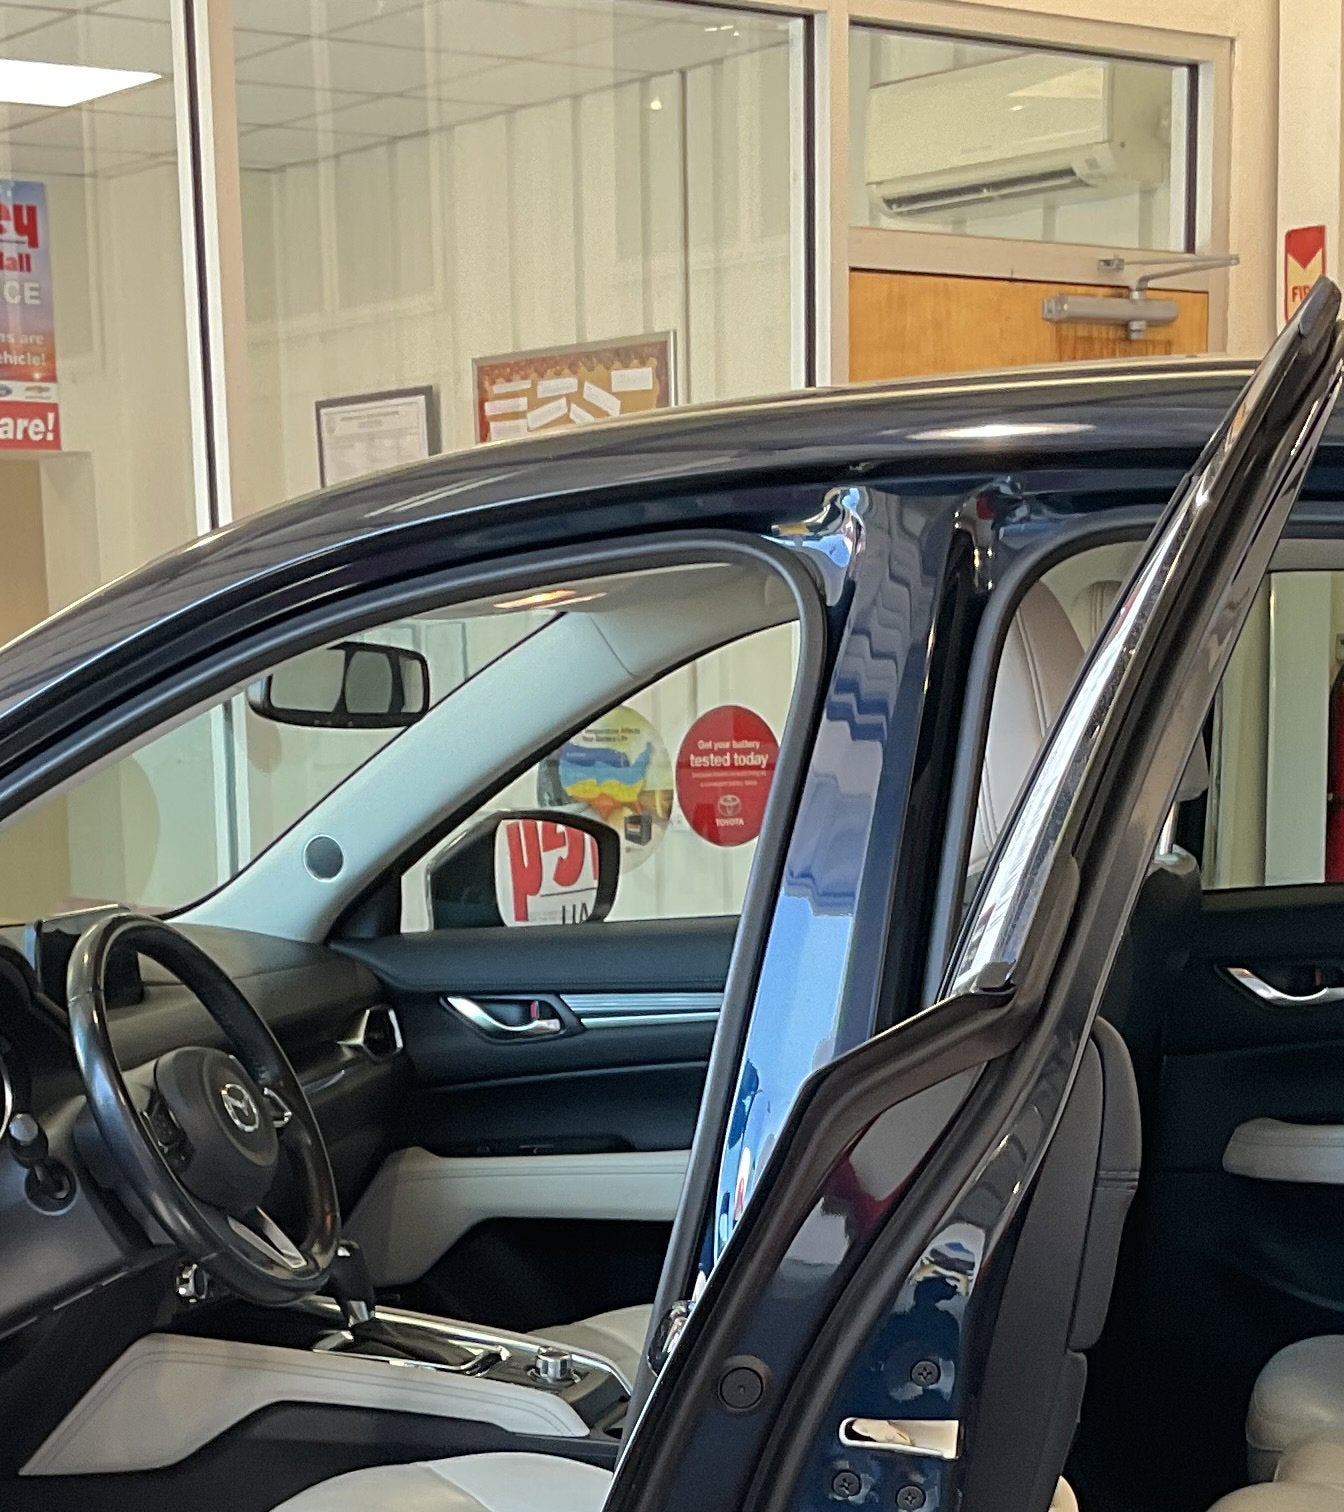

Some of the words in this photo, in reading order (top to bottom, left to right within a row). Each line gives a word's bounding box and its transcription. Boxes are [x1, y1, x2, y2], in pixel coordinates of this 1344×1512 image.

[18, 333, 44, 345] are
[689, 752, 731, 768] tested
[733, 751, 769, 769] today
[715, 817, 745, 827] TOYOTA
